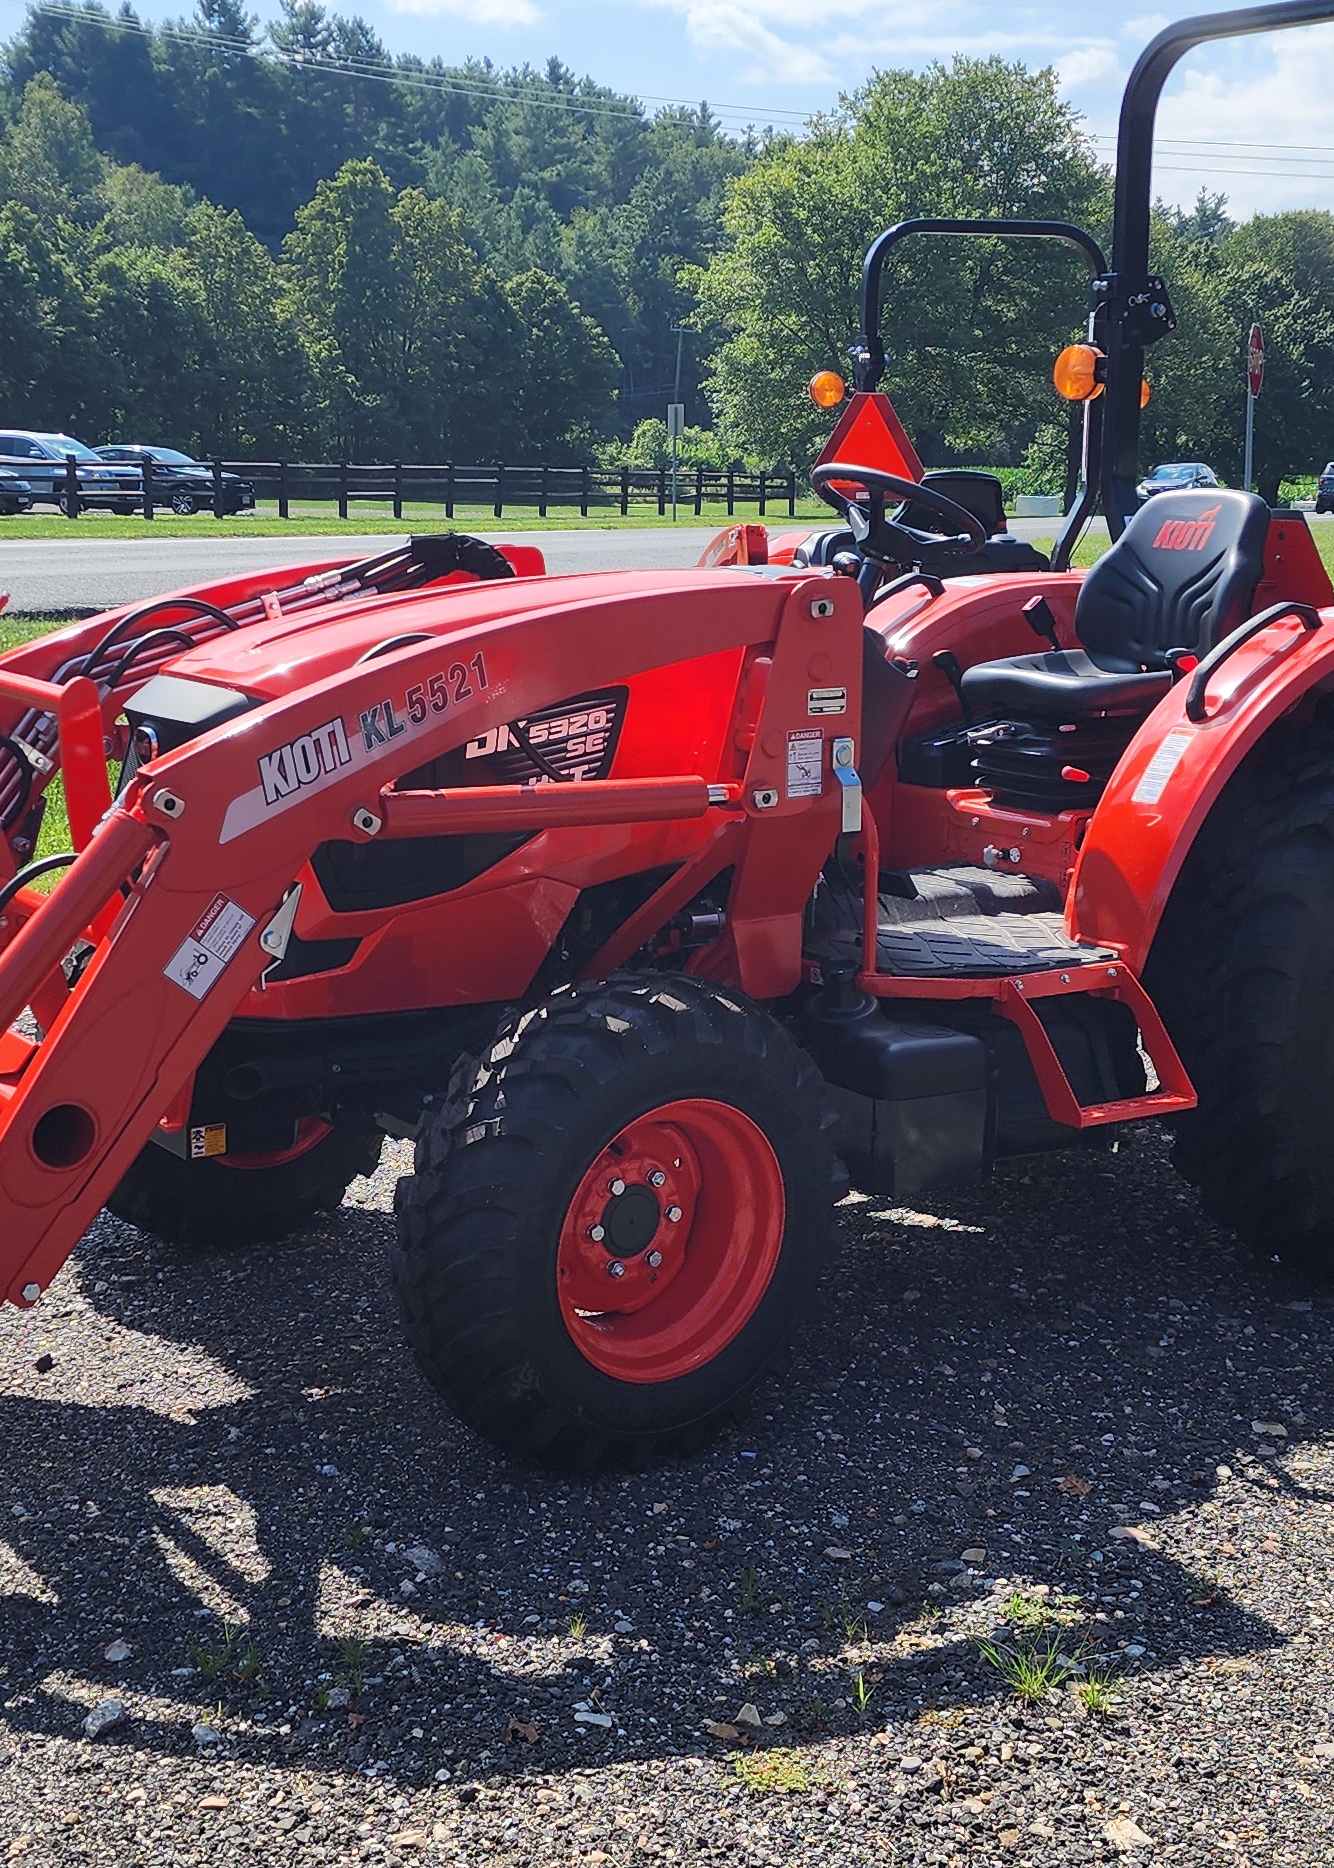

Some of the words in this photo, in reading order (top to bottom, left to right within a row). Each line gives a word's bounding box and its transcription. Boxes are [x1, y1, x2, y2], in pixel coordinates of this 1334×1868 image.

[1152, 519, 1216, 551] KIOTI
[528, 710, 607, 746] 5320
[795, 731, 821, 740] DANGER
[258, 715, 352, 806] KIOTI
[564, 731, 606, 759] SE
[199, 898, 225, 930] DANGER
